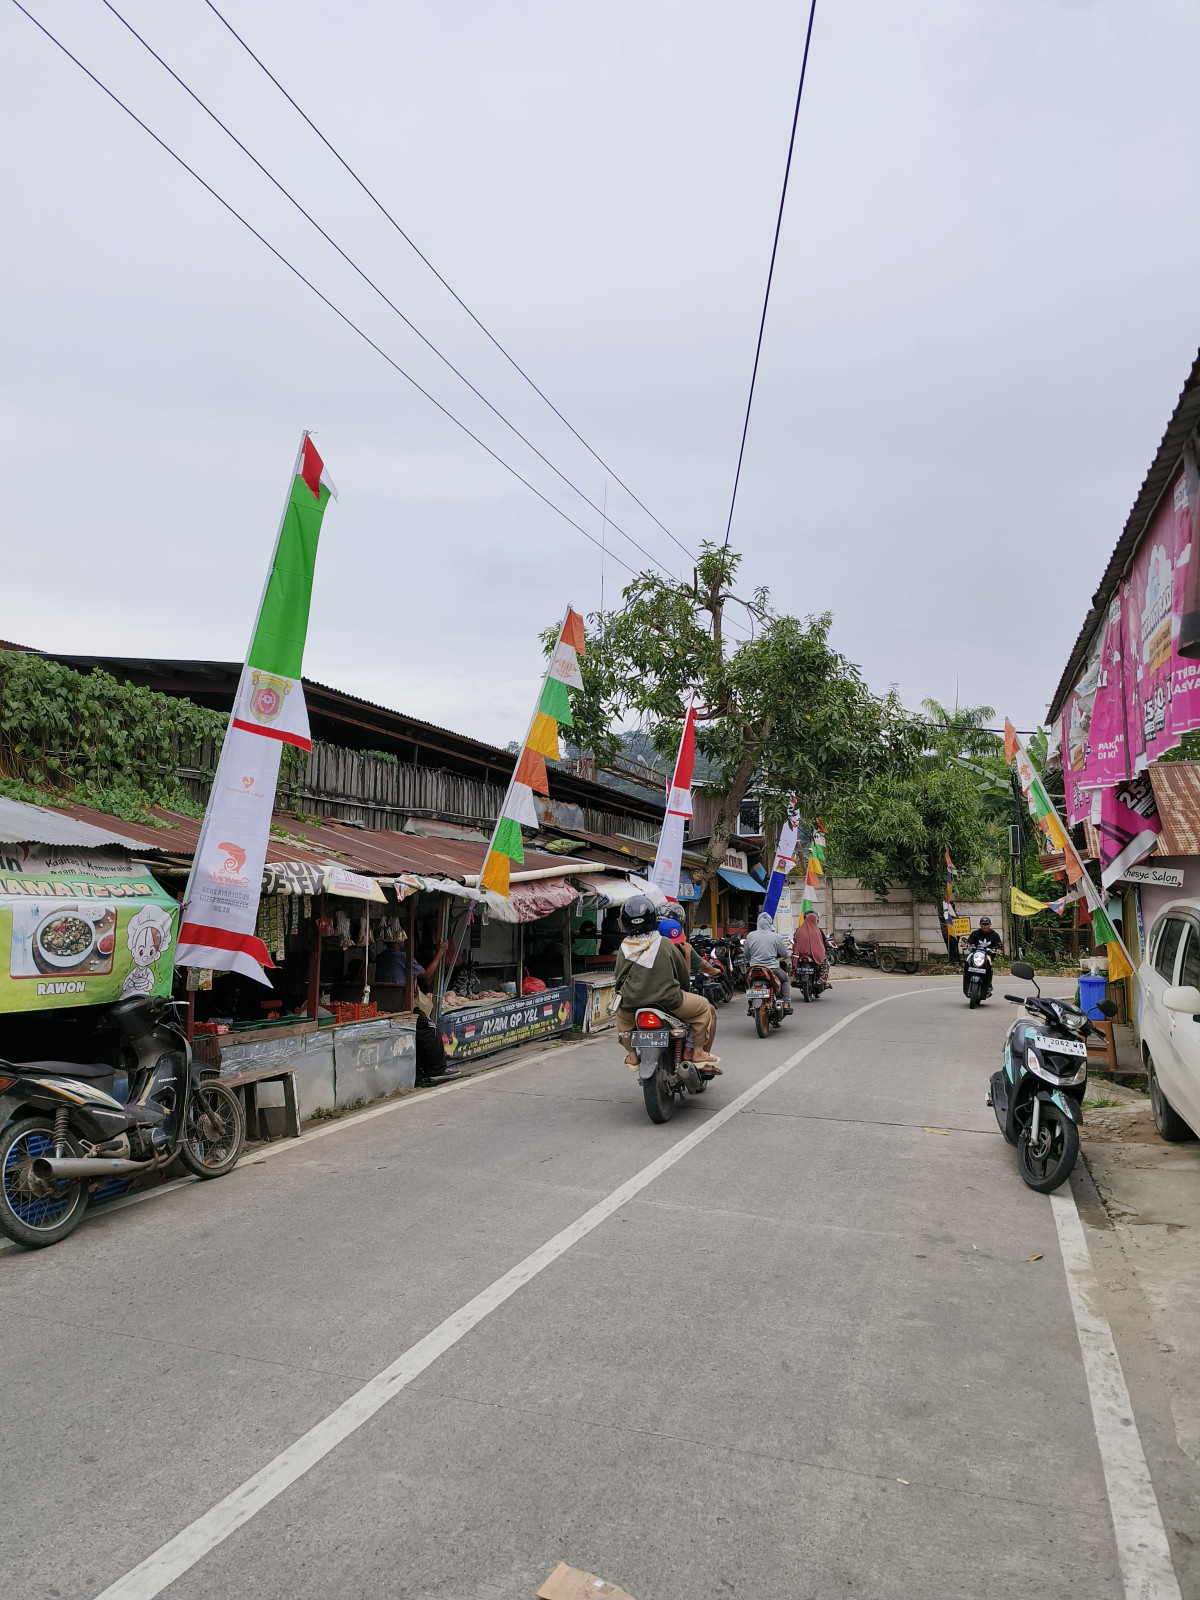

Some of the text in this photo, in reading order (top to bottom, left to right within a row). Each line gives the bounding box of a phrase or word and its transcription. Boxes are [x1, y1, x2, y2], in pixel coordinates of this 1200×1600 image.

[45, 856, 78, 868] Kualitas
[1152, 871, 1178, 882] Salon
[37, 981, 86, 995] RAWON
[481, 1018, 508, 1036] AYAM
[509, 1013, 523, 1028] GP
[524, 1008, 538, 1023] Y&L
